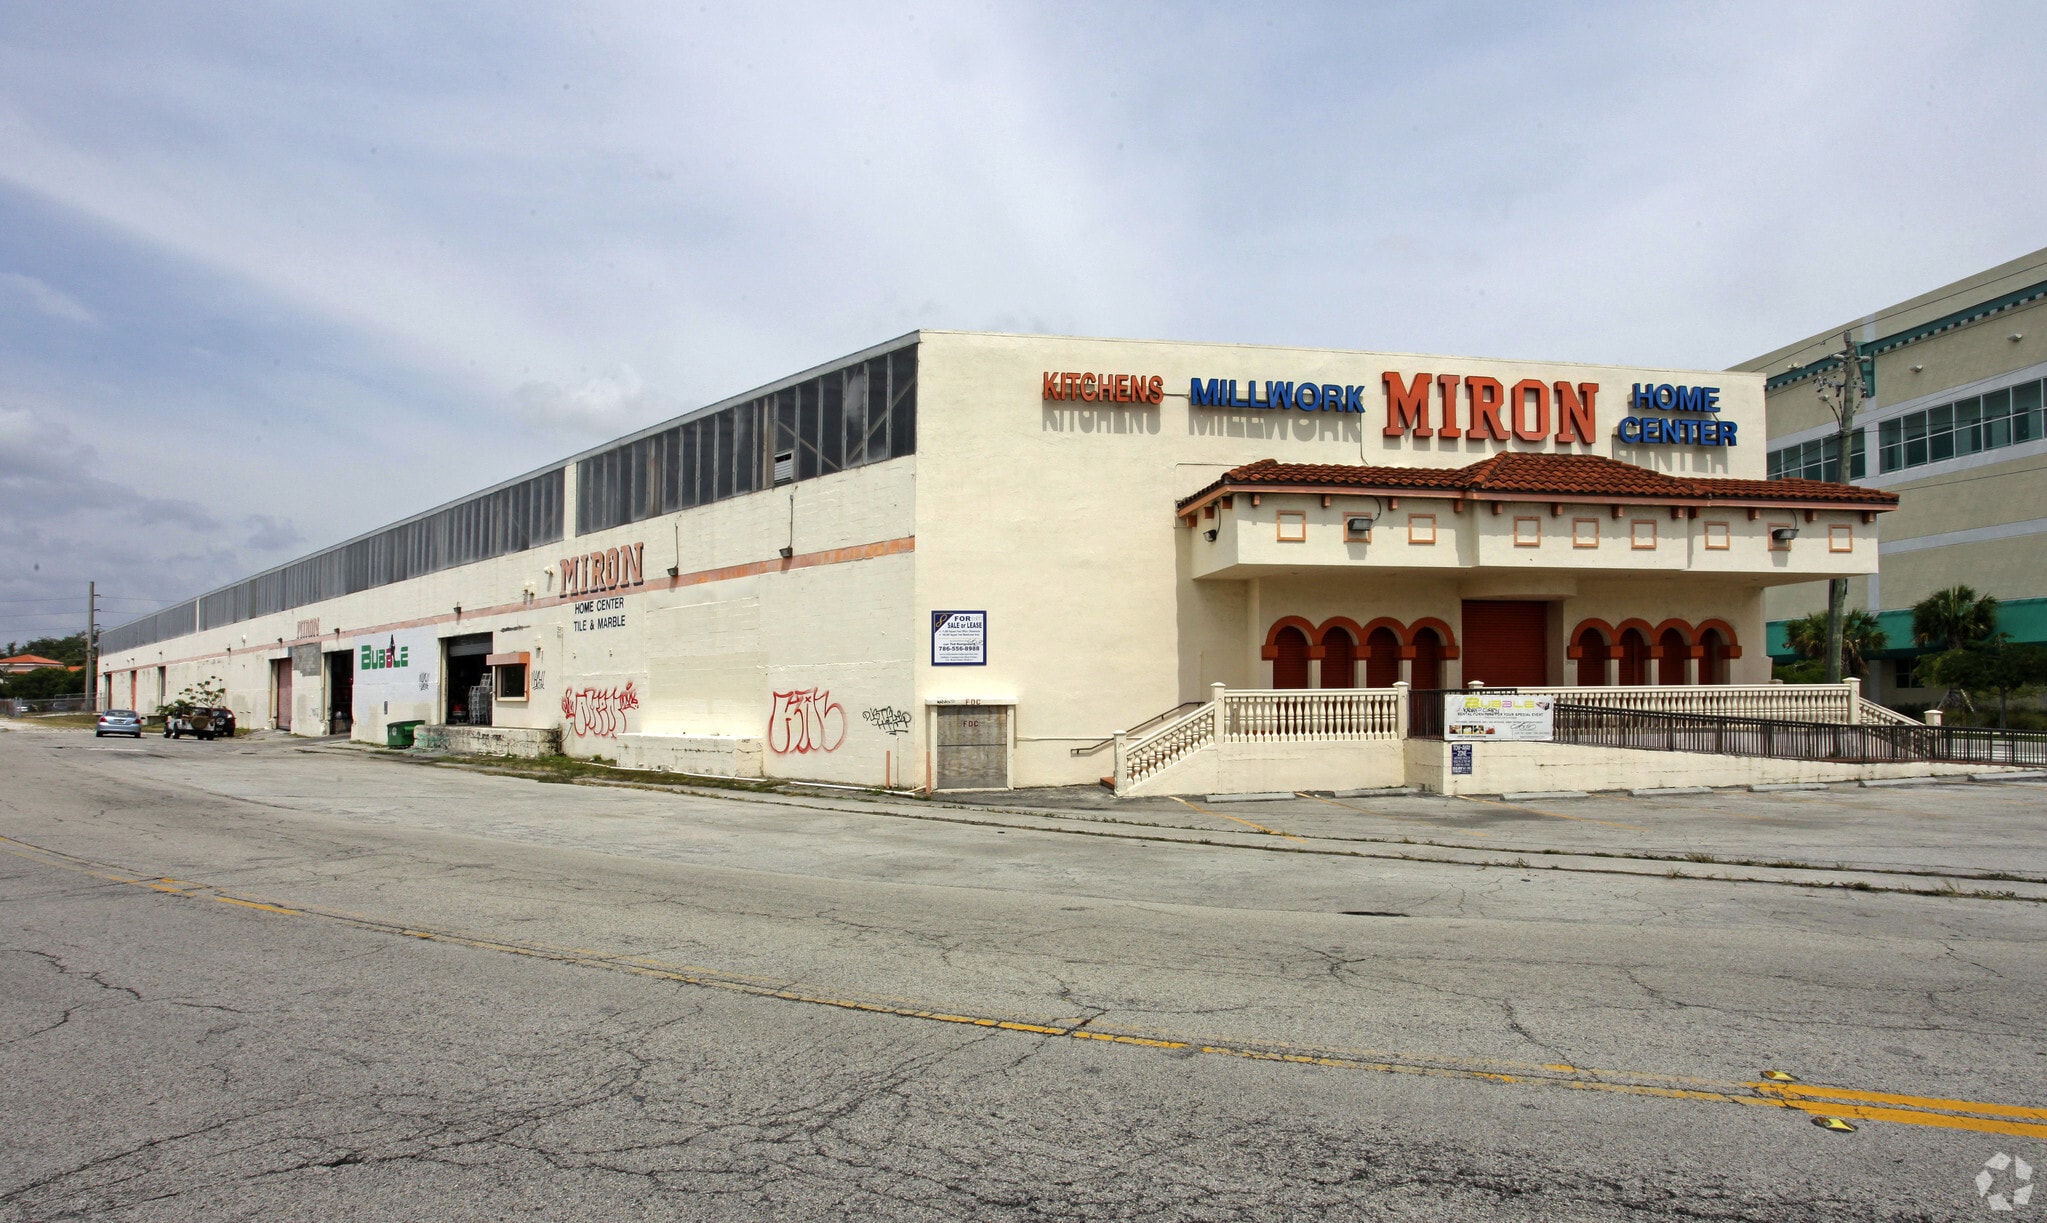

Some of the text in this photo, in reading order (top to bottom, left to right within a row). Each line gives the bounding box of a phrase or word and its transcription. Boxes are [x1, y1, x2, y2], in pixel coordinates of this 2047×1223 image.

[1042, 371, 1164, 405] KITCHENS
[1190, 377, 1366, 413] MILLWORK
[1631, 382, 1721, 413] HOME
[1381, 371, 1599, 445] MIRON
[1618, 415, 1739, 447] CENTER
[559, 541, 644, 598] MIRON
[574, 597, 625, 615] HOME CENTER
[573, 620, 587, 632] TILE
[589, 619, 595, 631] &
[597, 615, 626, 630] MARBLE
[947, 621, 960, 629] SALE
[966, 621, 983, 629] LEASE
[361, 644, 409, 671] BUBBLE
